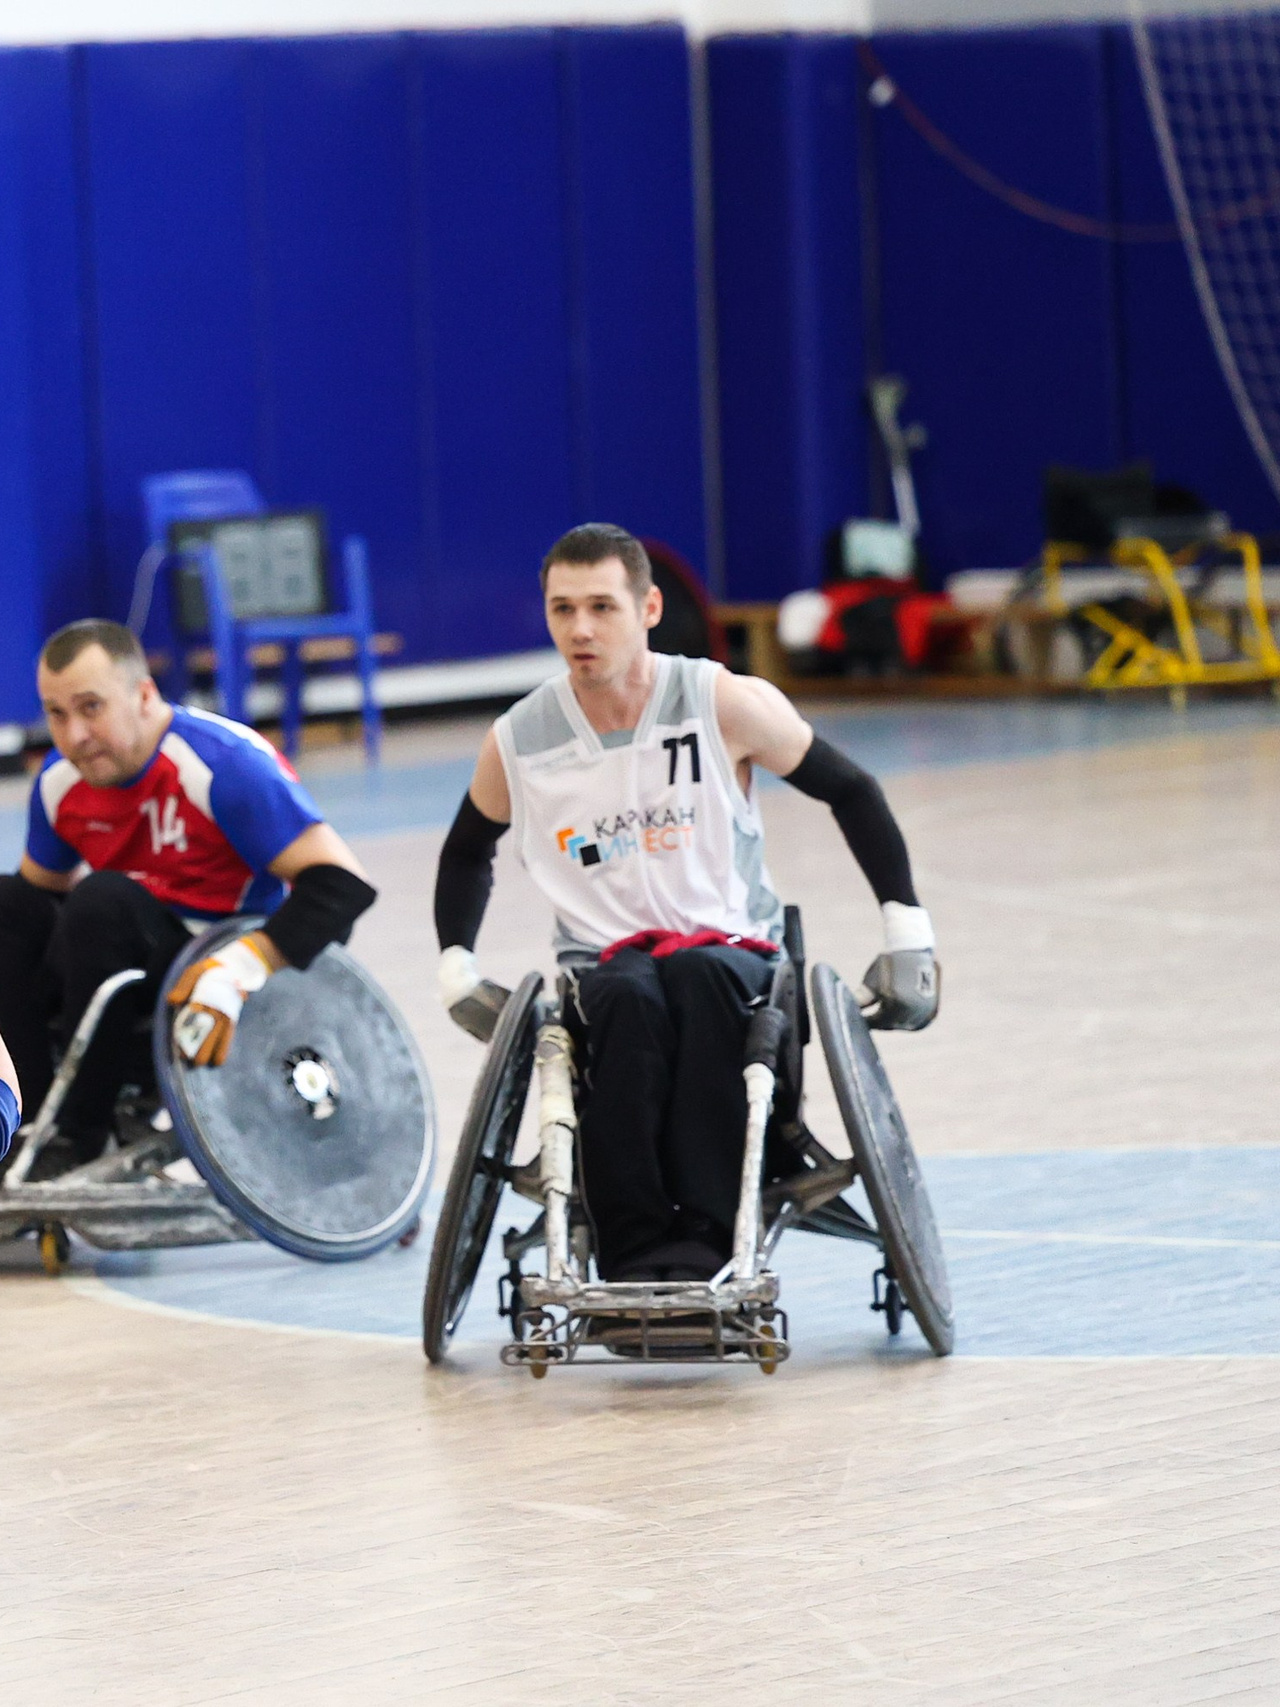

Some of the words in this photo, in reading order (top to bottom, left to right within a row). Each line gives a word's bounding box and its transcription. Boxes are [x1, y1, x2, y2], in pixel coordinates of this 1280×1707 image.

[139, 795, 187, 854] 14
[594, 806, 695, 839] КАРКАН
[598, 824, 695, 862] ИНЕСТ
